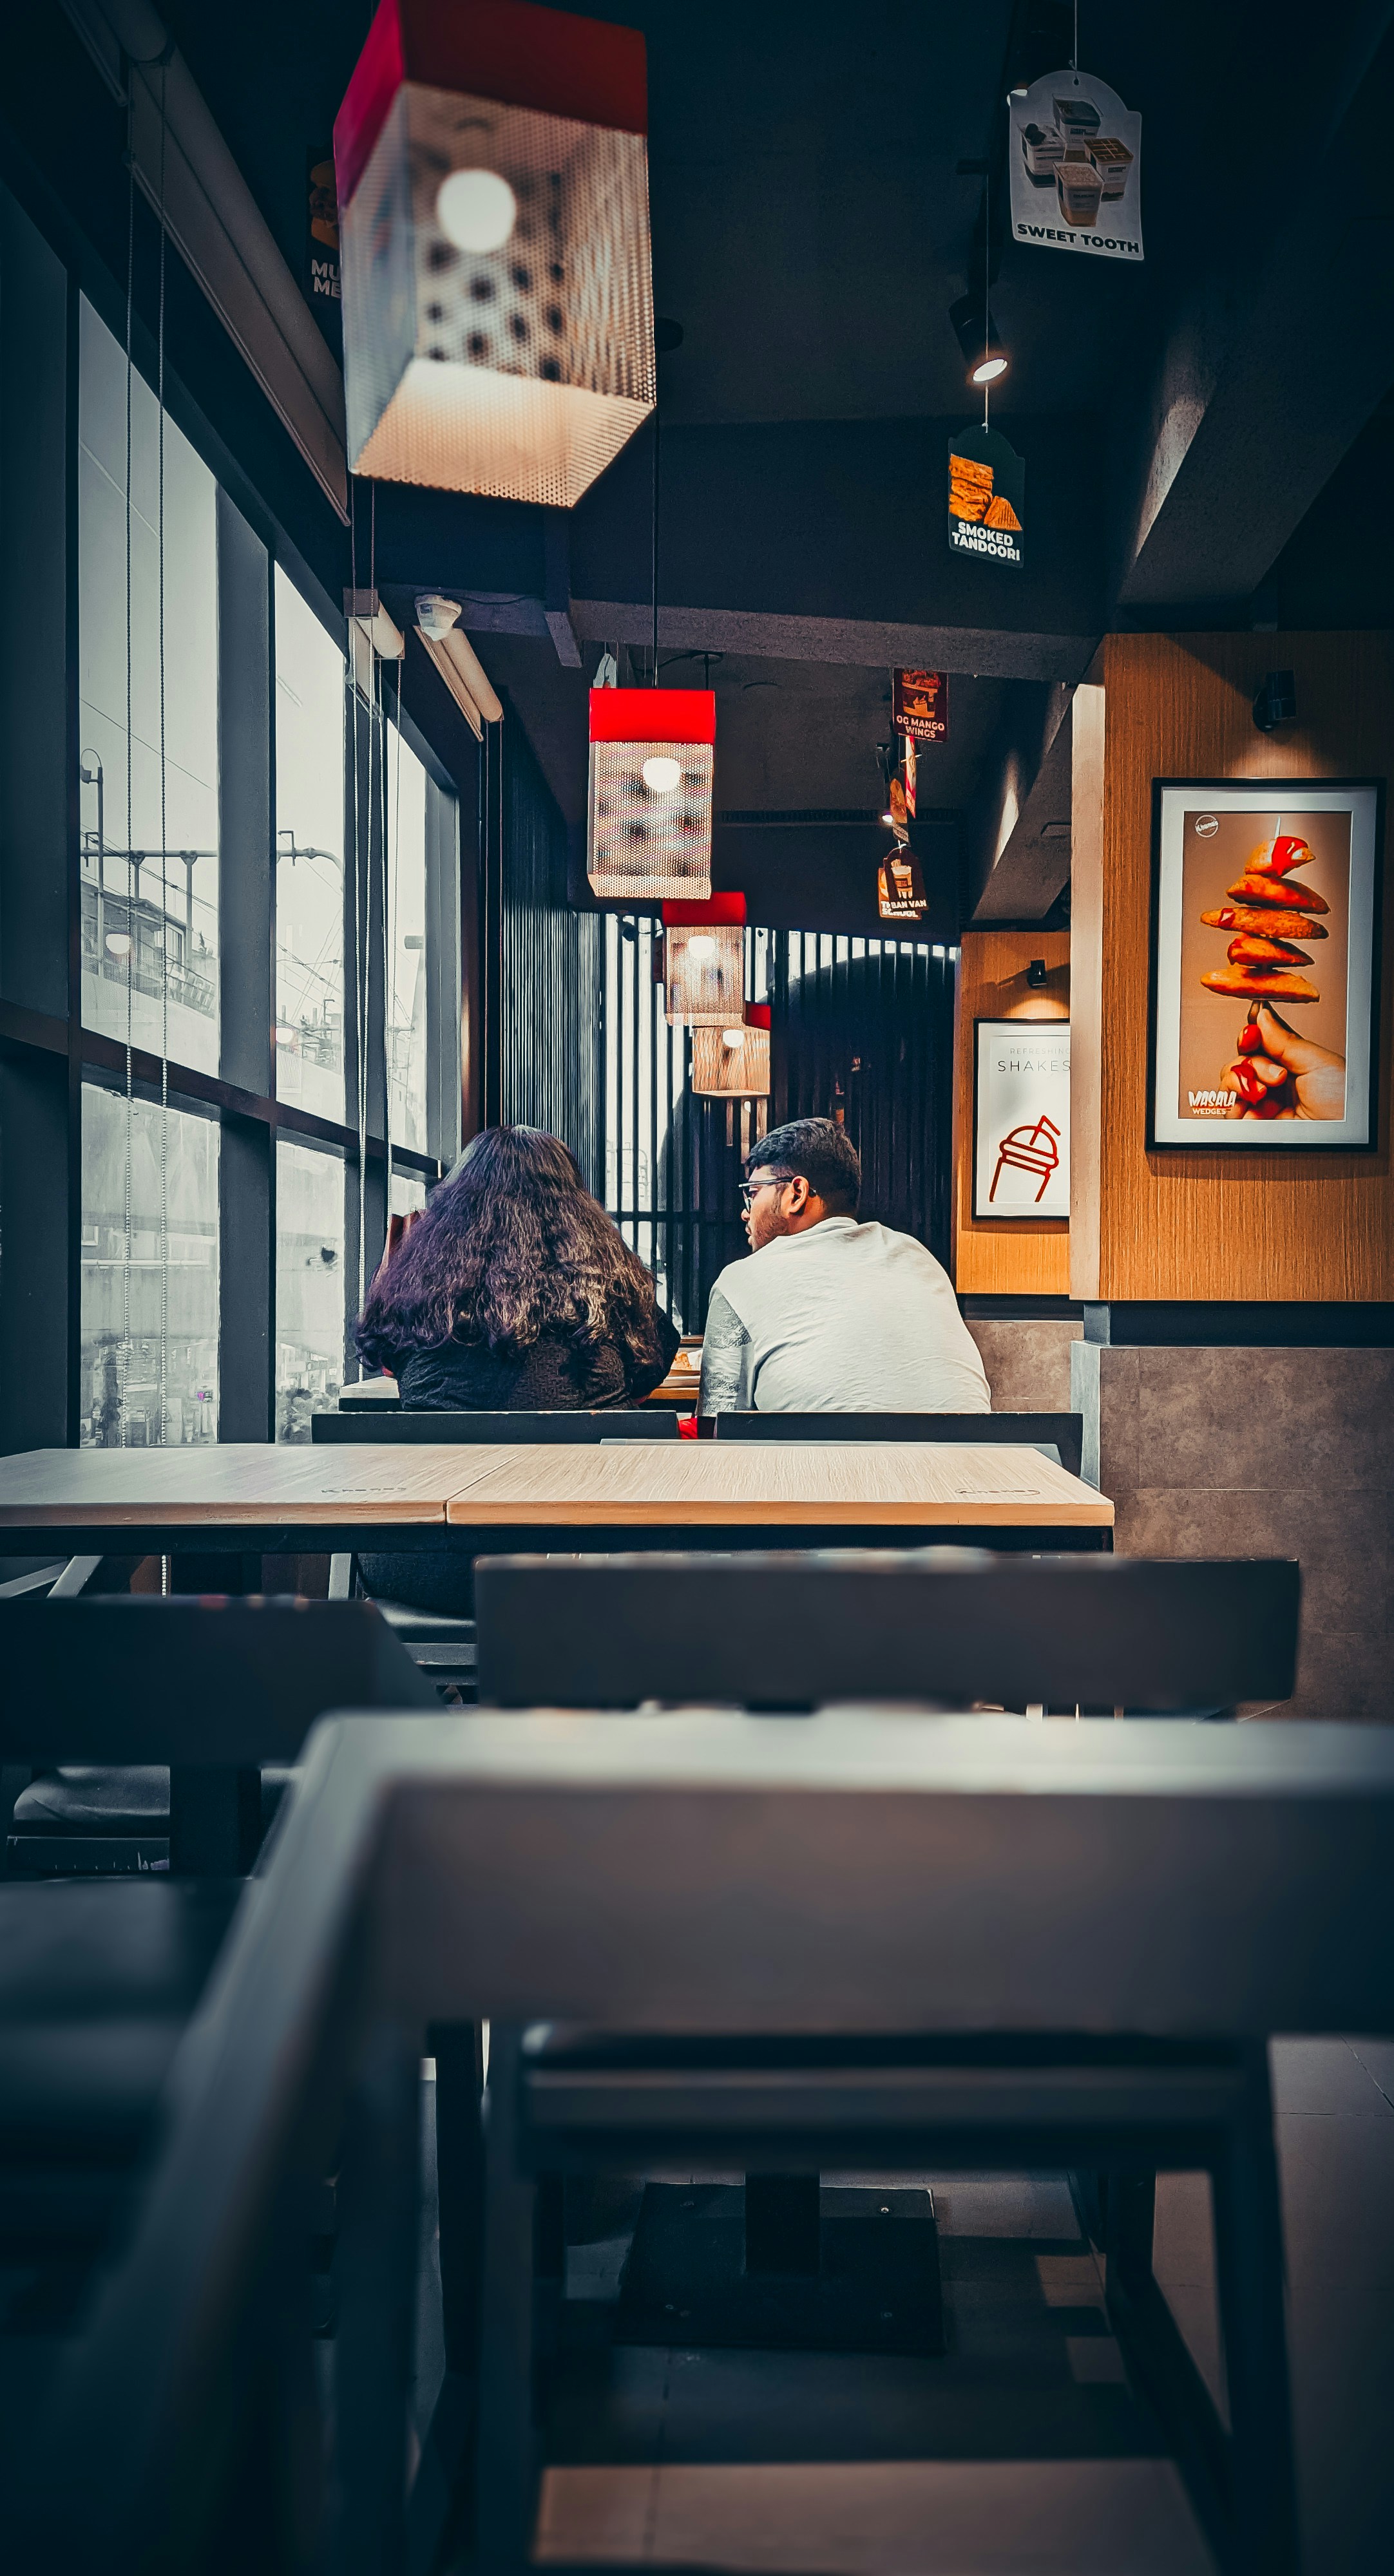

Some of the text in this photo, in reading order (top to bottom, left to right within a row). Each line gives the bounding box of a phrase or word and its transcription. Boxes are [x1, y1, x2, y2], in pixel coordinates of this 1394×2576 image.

[1017, 223, 1140, 253] SWEET TOOTH
[958, 522, 1013, 546] SMOKED
[952, 531, 1020, 561] TANDOORI
[896, 715, 945, 731] OG MANGO
[905, 725, 936, 739] WINGS
[908, 899, 927, 908] VAN
[998, 1060, 1071, 1072] SHAKES
[1188, 1090, 1237, 1107] MASALA
